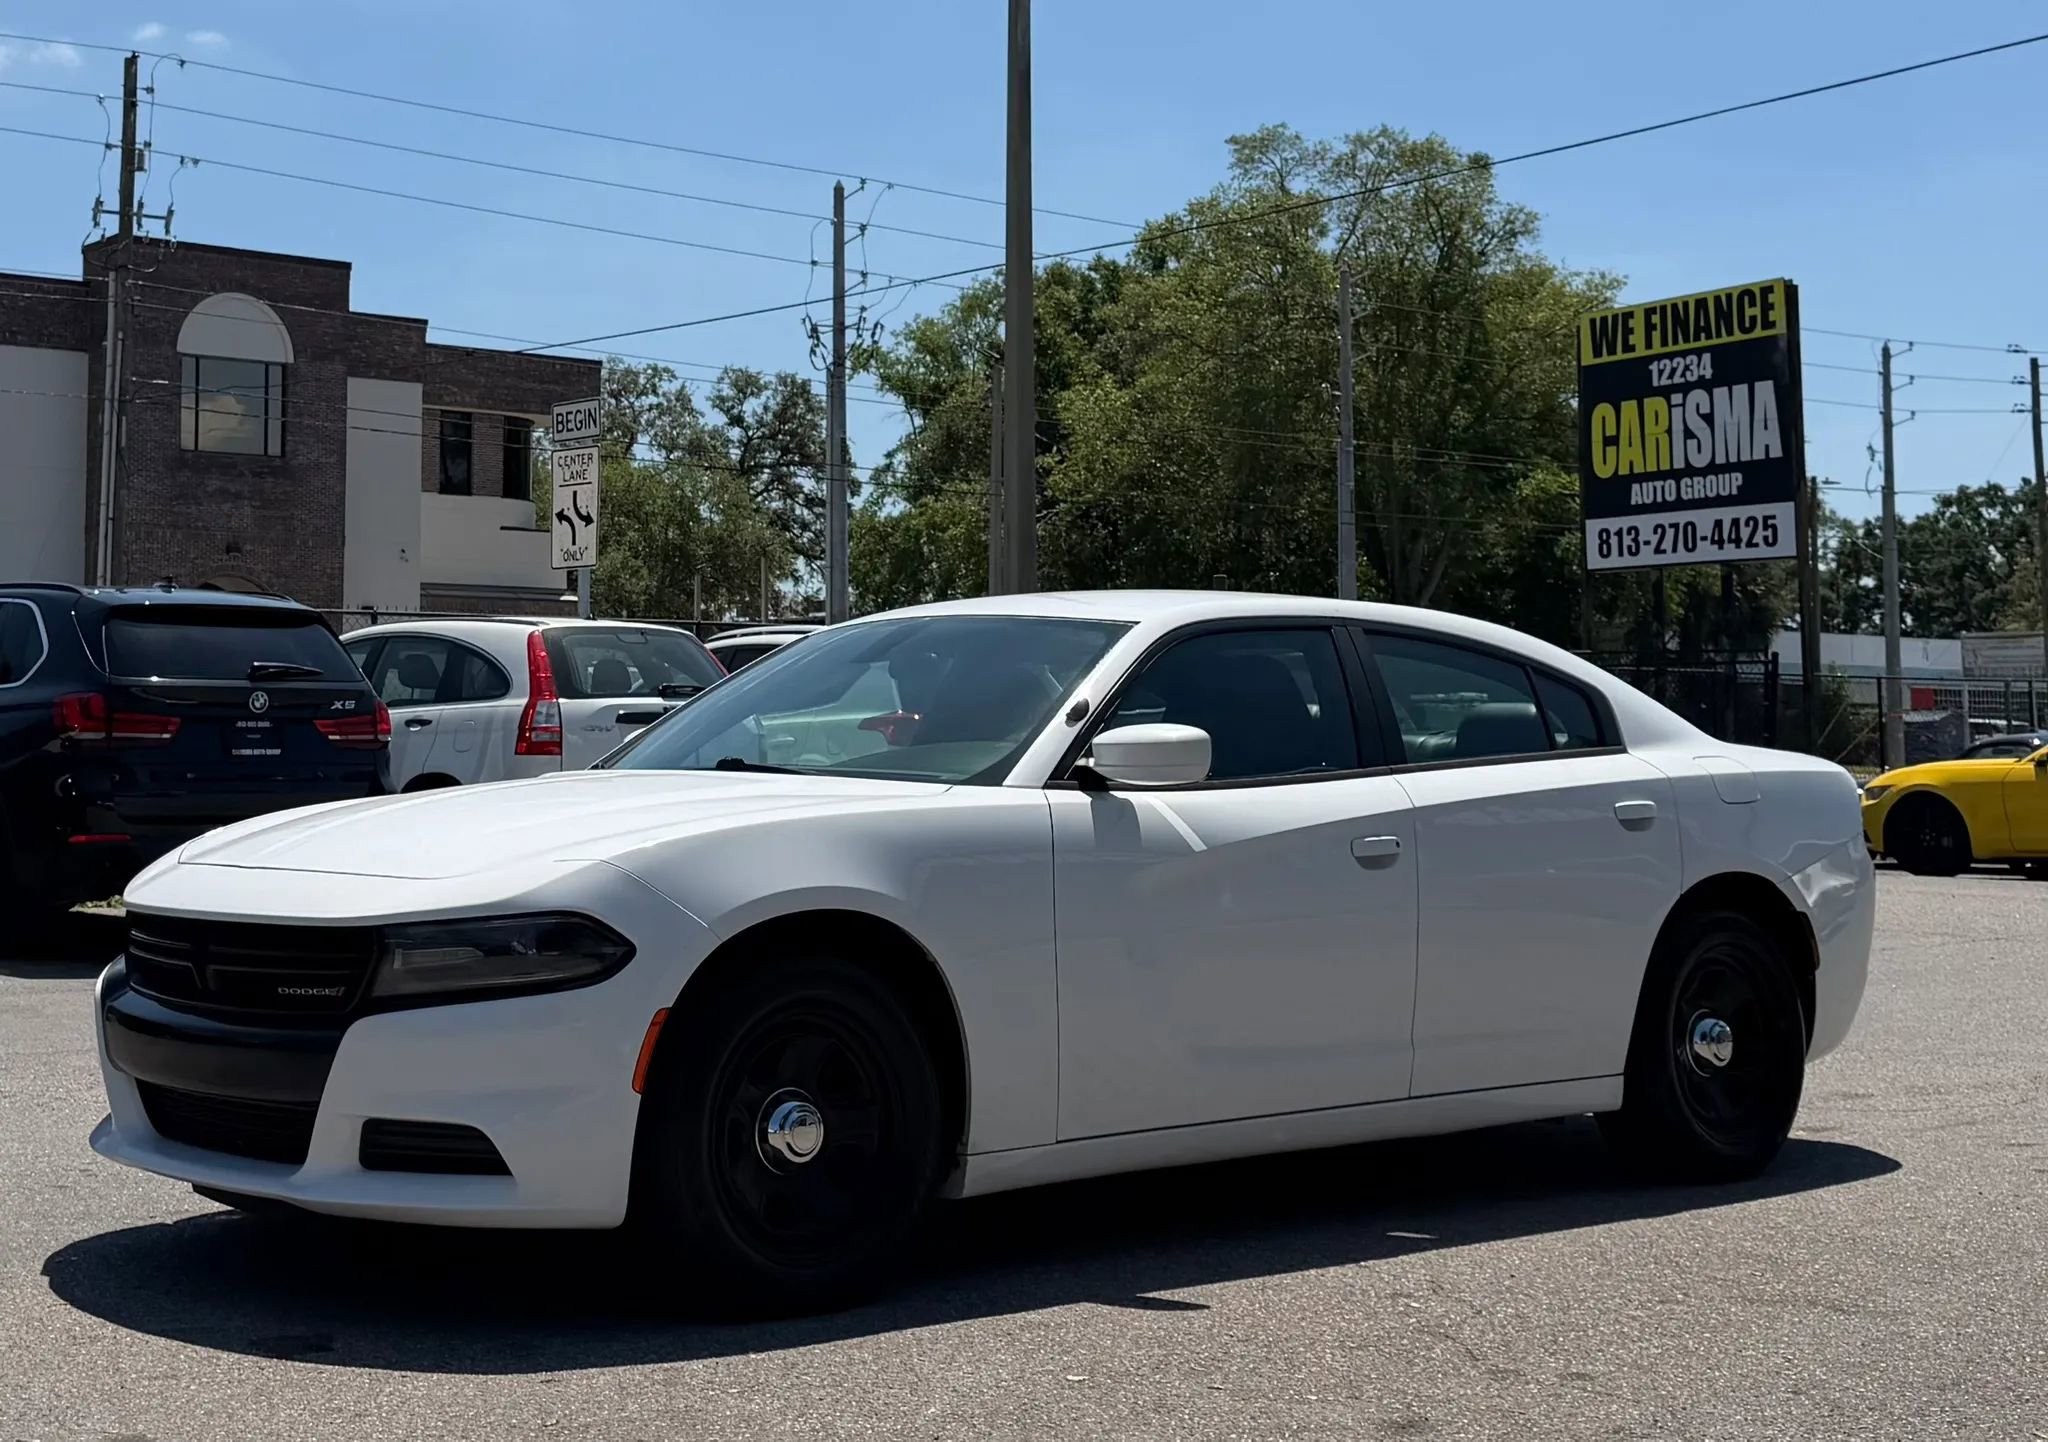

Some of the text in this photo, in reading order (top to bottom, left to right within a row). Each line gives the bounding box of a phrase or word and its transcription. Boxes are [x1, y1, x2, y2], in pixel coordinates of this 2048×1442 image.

[1589, 285, 1777, 359] WE FINANCE
[1649, 353, 1713, 387] 12234
[556, 407, 597, 434] BEGIN
[557, 453, 593, 468] CENTER
[563, 469, 588, 482] LANE
[1631, 472, 1743, 505] AUTO GROUP
[1597, 515, 1779, 559] 813-270-4425
[563, 548, 585, 562] ONLY
[330, 700, 356, 709] X5
[278, 987, 337, 996] DODGE
